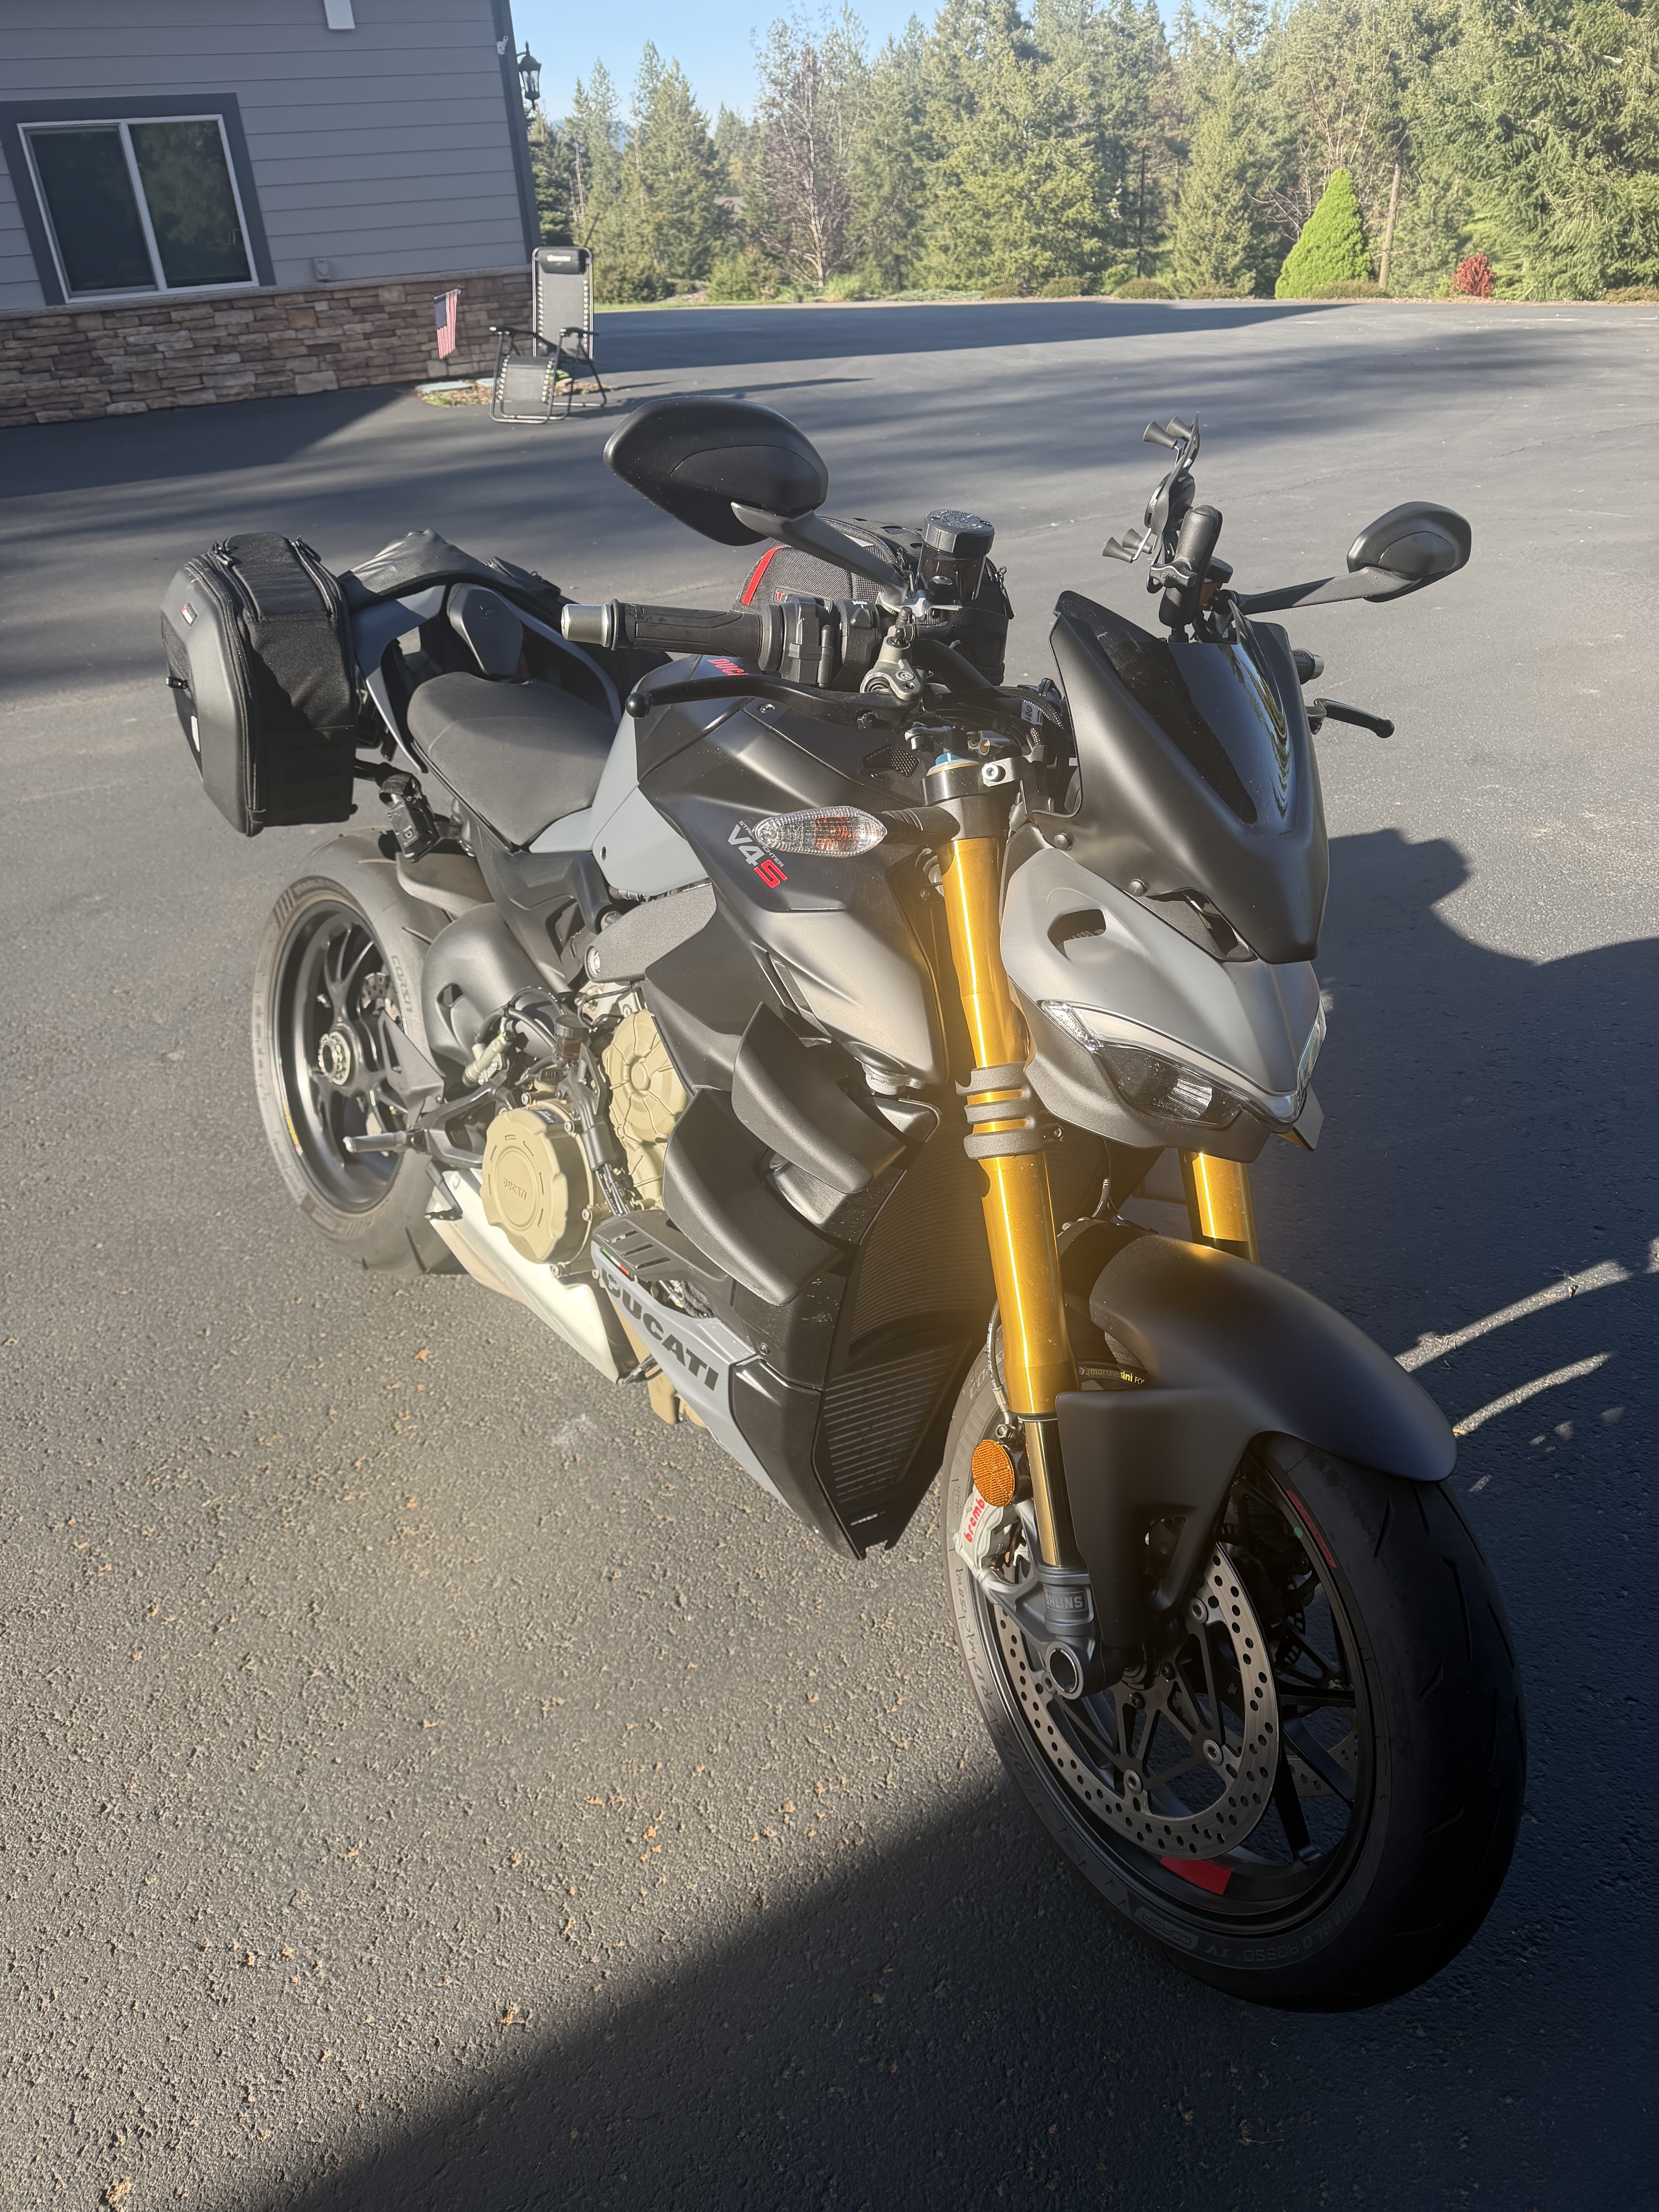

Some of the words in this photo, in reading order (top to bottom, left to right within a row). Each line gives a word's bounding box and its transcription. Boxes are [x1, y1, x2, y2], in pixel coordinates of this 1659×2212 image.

[503, 1177, 527, 1200] DUCATI
[600, 1267, 719, 1391] DUCATI
[963, 1498, 985, 1543] bremb
[1141, 1910, 1192, 1946] CORSA
[1244, 1941, 1299, 1962] ROSSO
